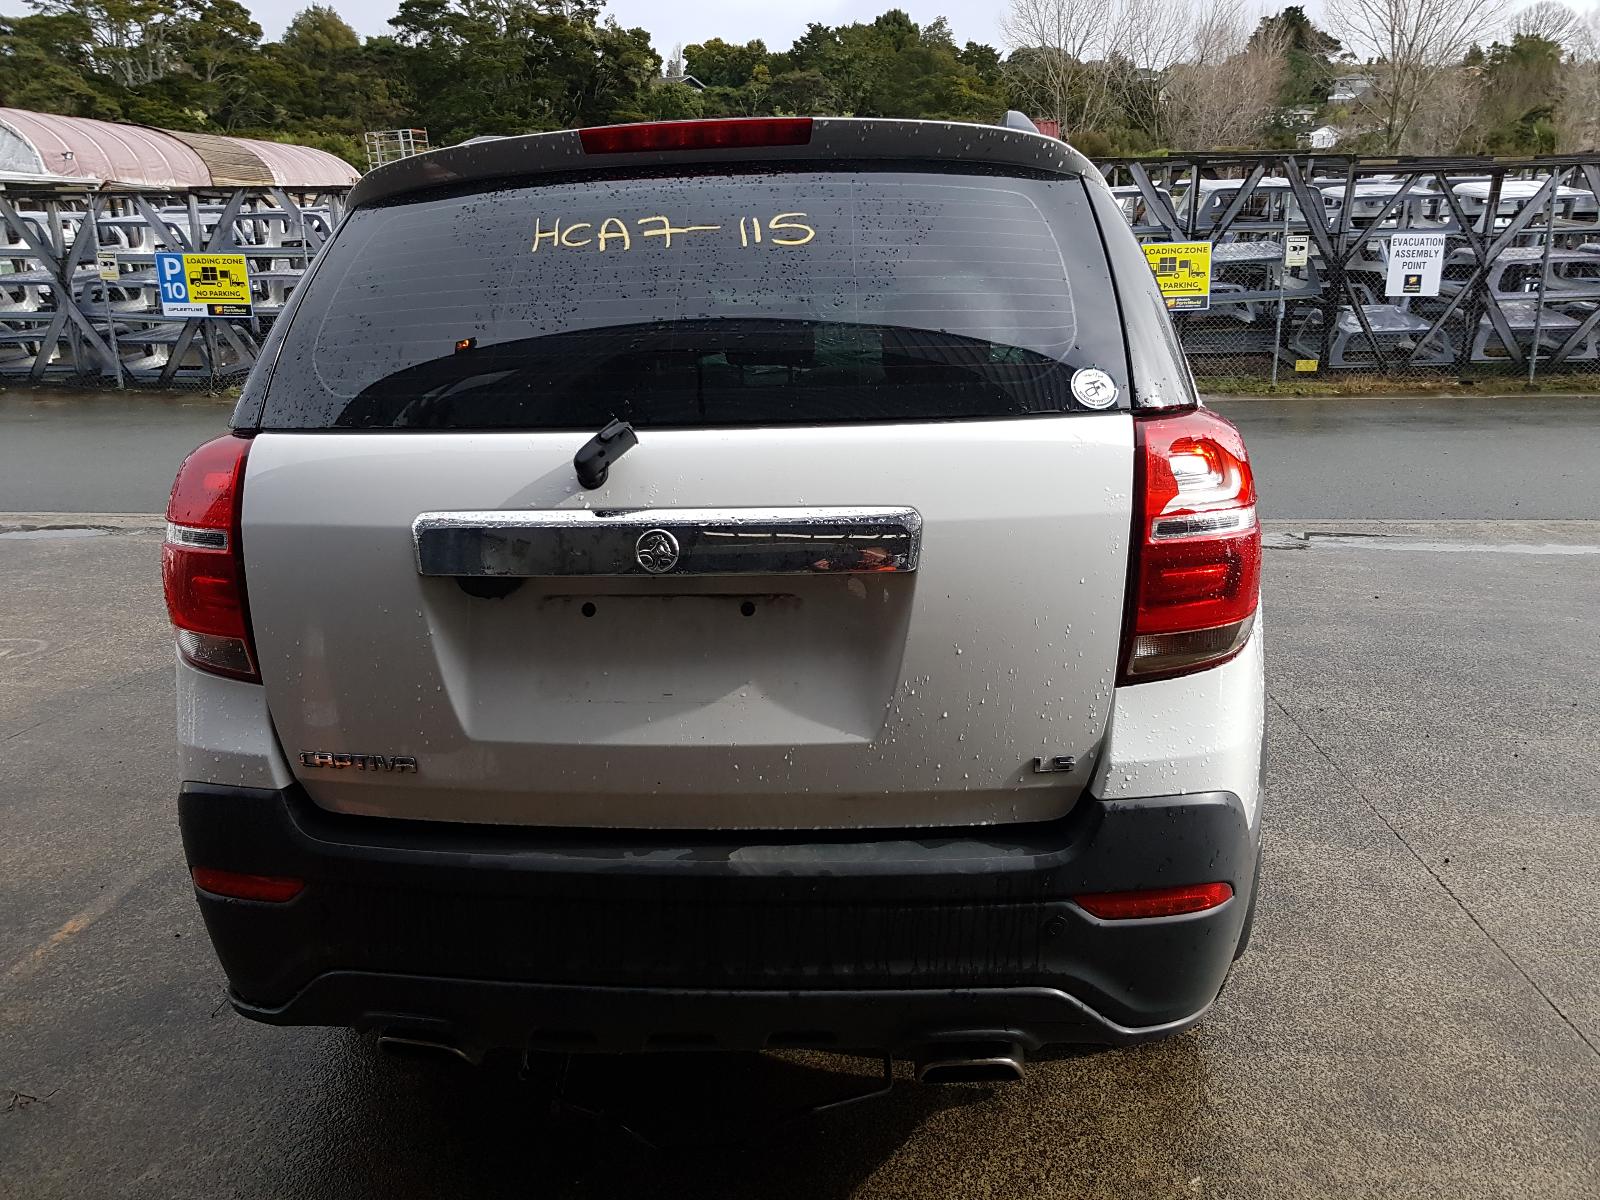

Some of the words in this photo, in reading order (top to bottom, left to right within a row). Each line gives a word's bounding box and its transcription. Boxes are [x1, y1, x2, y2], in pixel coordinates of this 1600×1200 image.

[1392, 238, 1444, 246] EVACUATION
[1144, 247, 1182, 255] LOADING
[1395, 249, 1440, 258] ASSEMBLY
[163, 257, 181, 281] P
[1402, 261, 1427, 270] POINT
[1163, 281, 1199, 289] PARKING
[163, 282, 186, 299] 10
[300, 751, 418, 773] CAPTIVA
